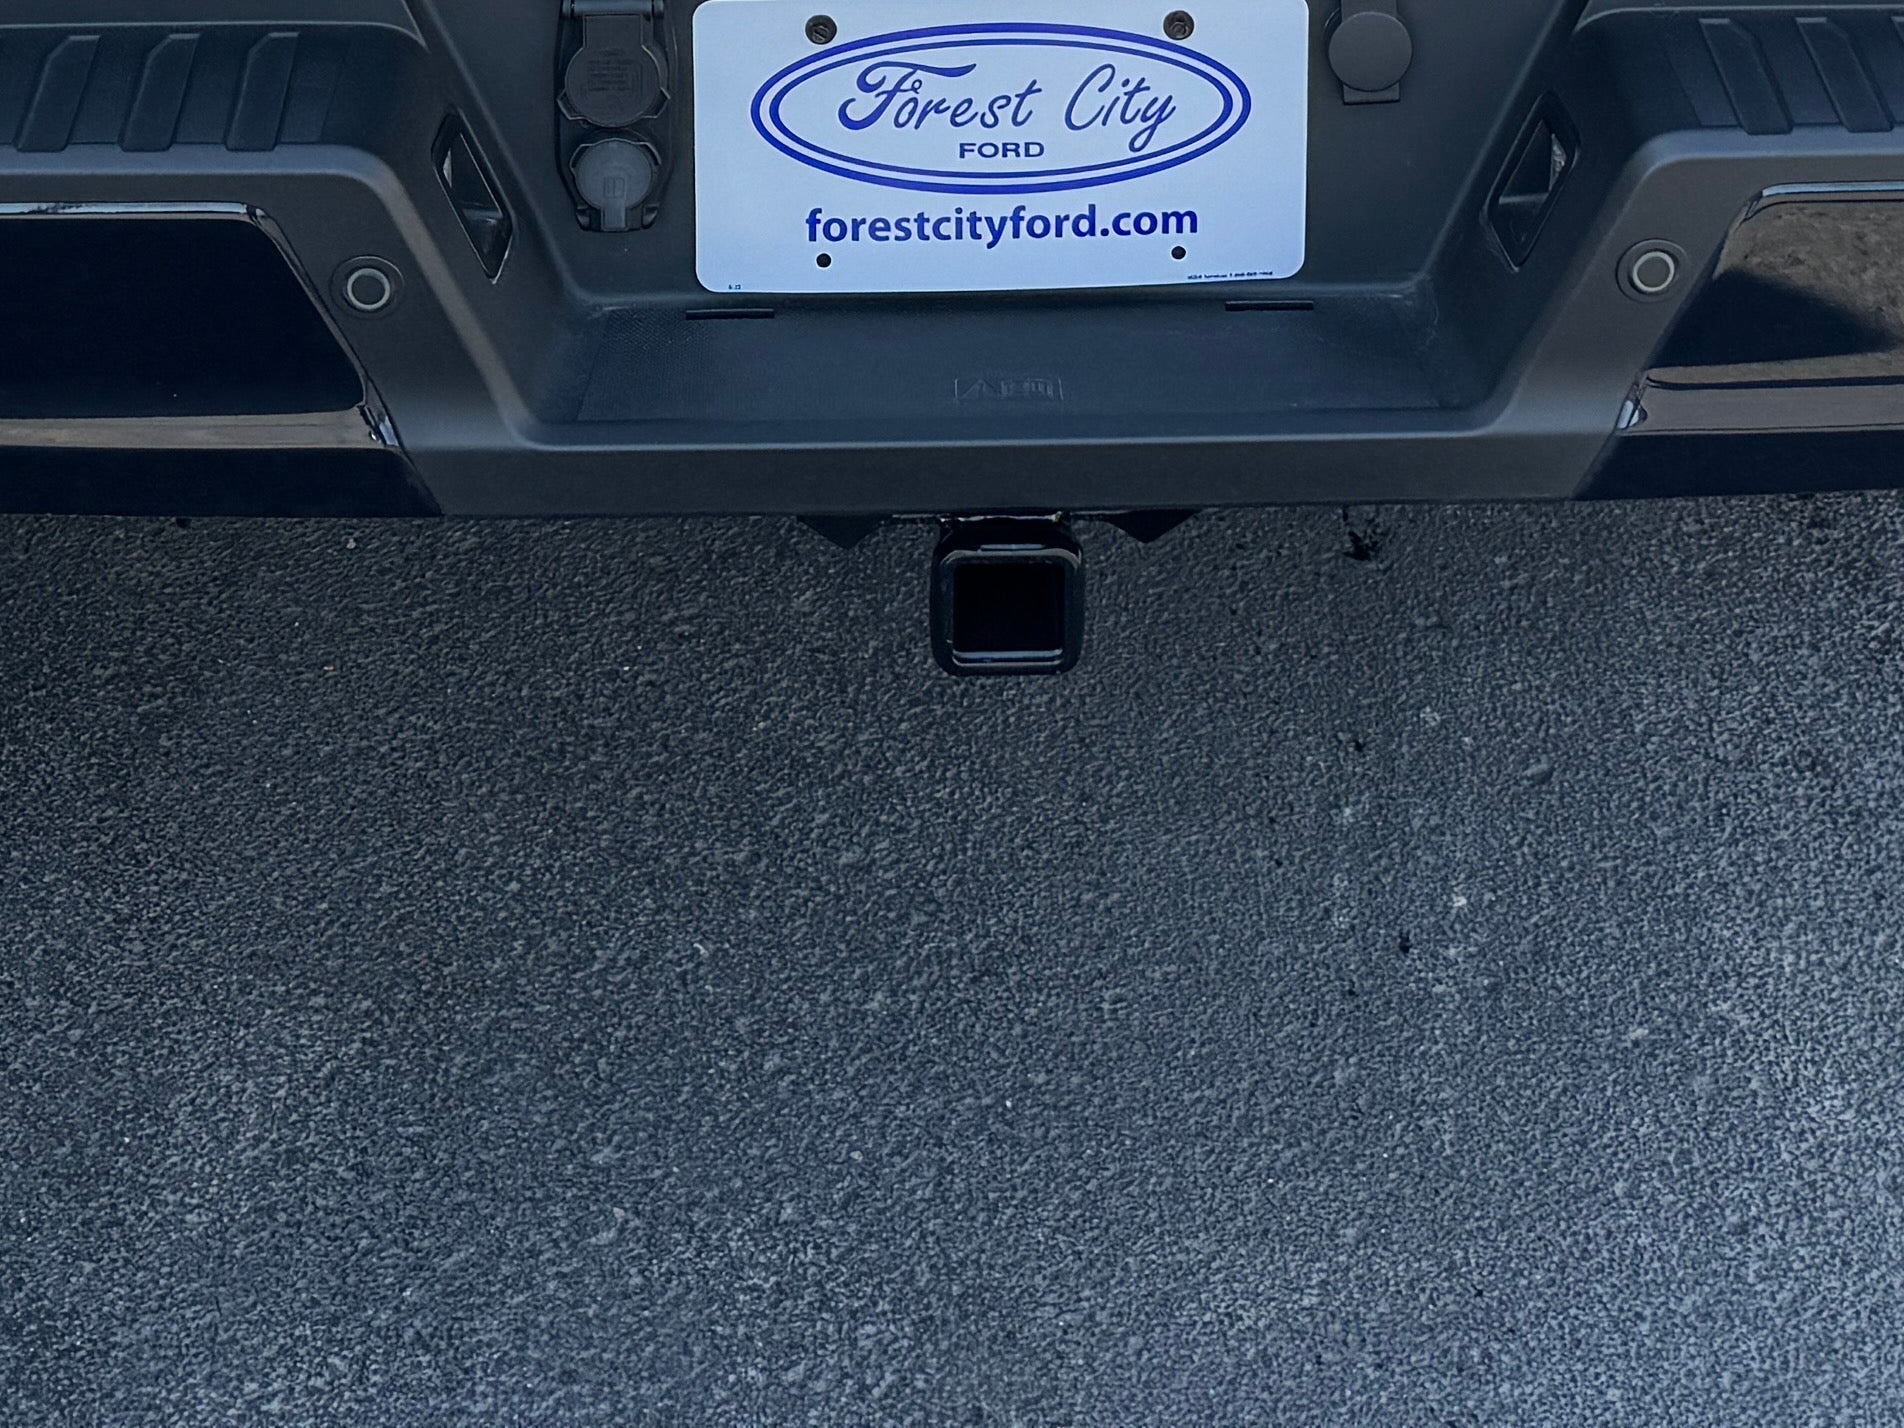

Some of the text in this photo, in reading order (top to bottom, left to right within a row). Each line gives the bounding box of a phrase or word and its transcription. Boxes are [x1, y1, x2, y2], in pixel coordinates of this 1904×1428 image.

[836, 60, 1177, 153] Forest City
[958, 141, 1046, 160] FORD
[805, 203, 1198, 251] forestcityford.com
